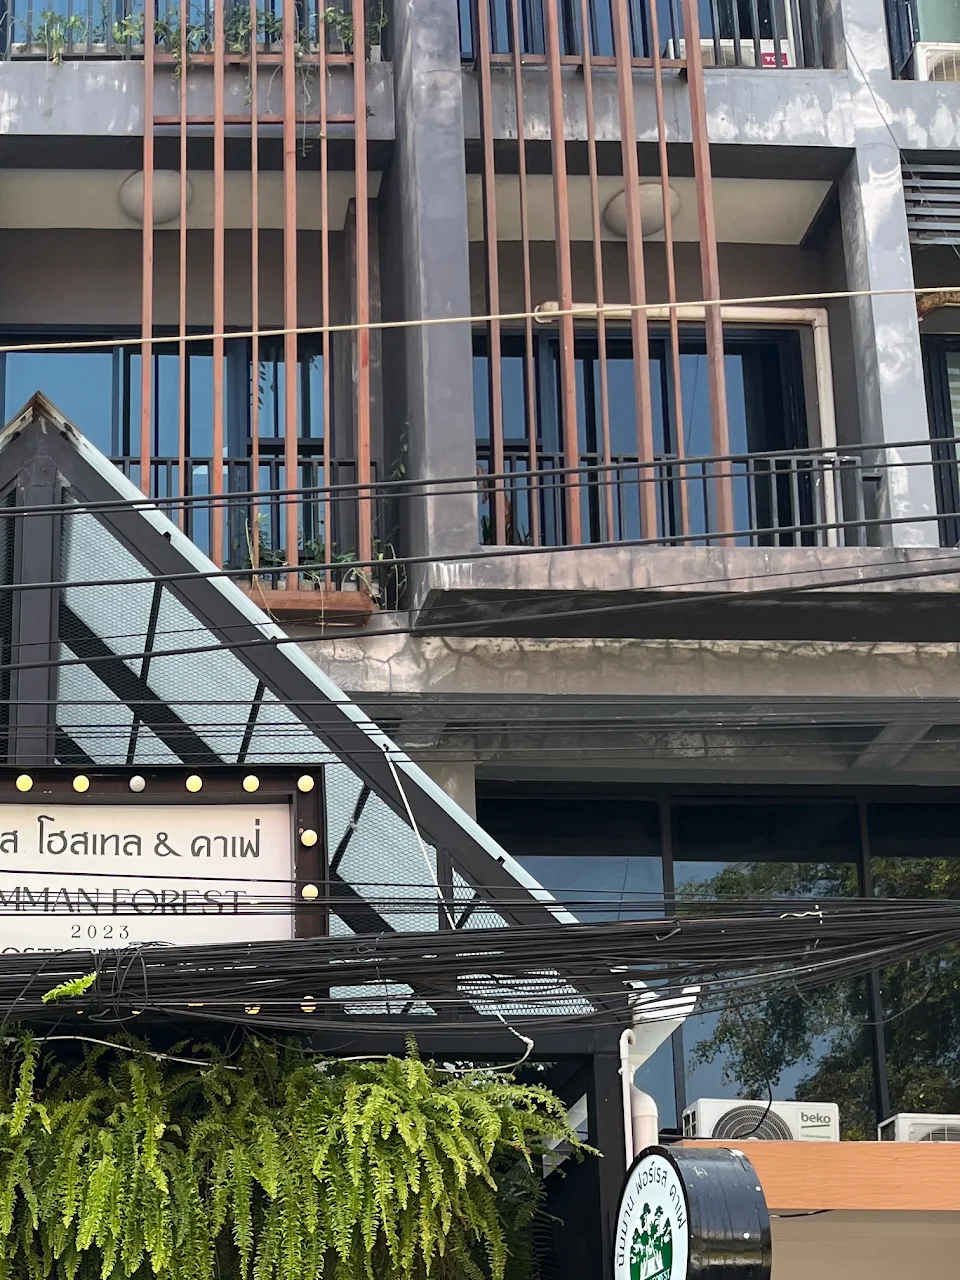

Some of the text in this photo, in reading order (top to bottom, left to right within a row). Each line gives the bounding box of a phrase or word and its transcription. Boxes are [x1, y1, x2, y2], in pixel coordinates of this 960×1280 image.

[37, 815, 142, 856] โฮสเทล
[153, 832, 183, 857] &
[190, 818, 261, 858] คาเฟ่
[112, 887, 247, 914] FOREST
[71, 924, 130, 939] 2023
[801, 1112, 831, 1123] beko
